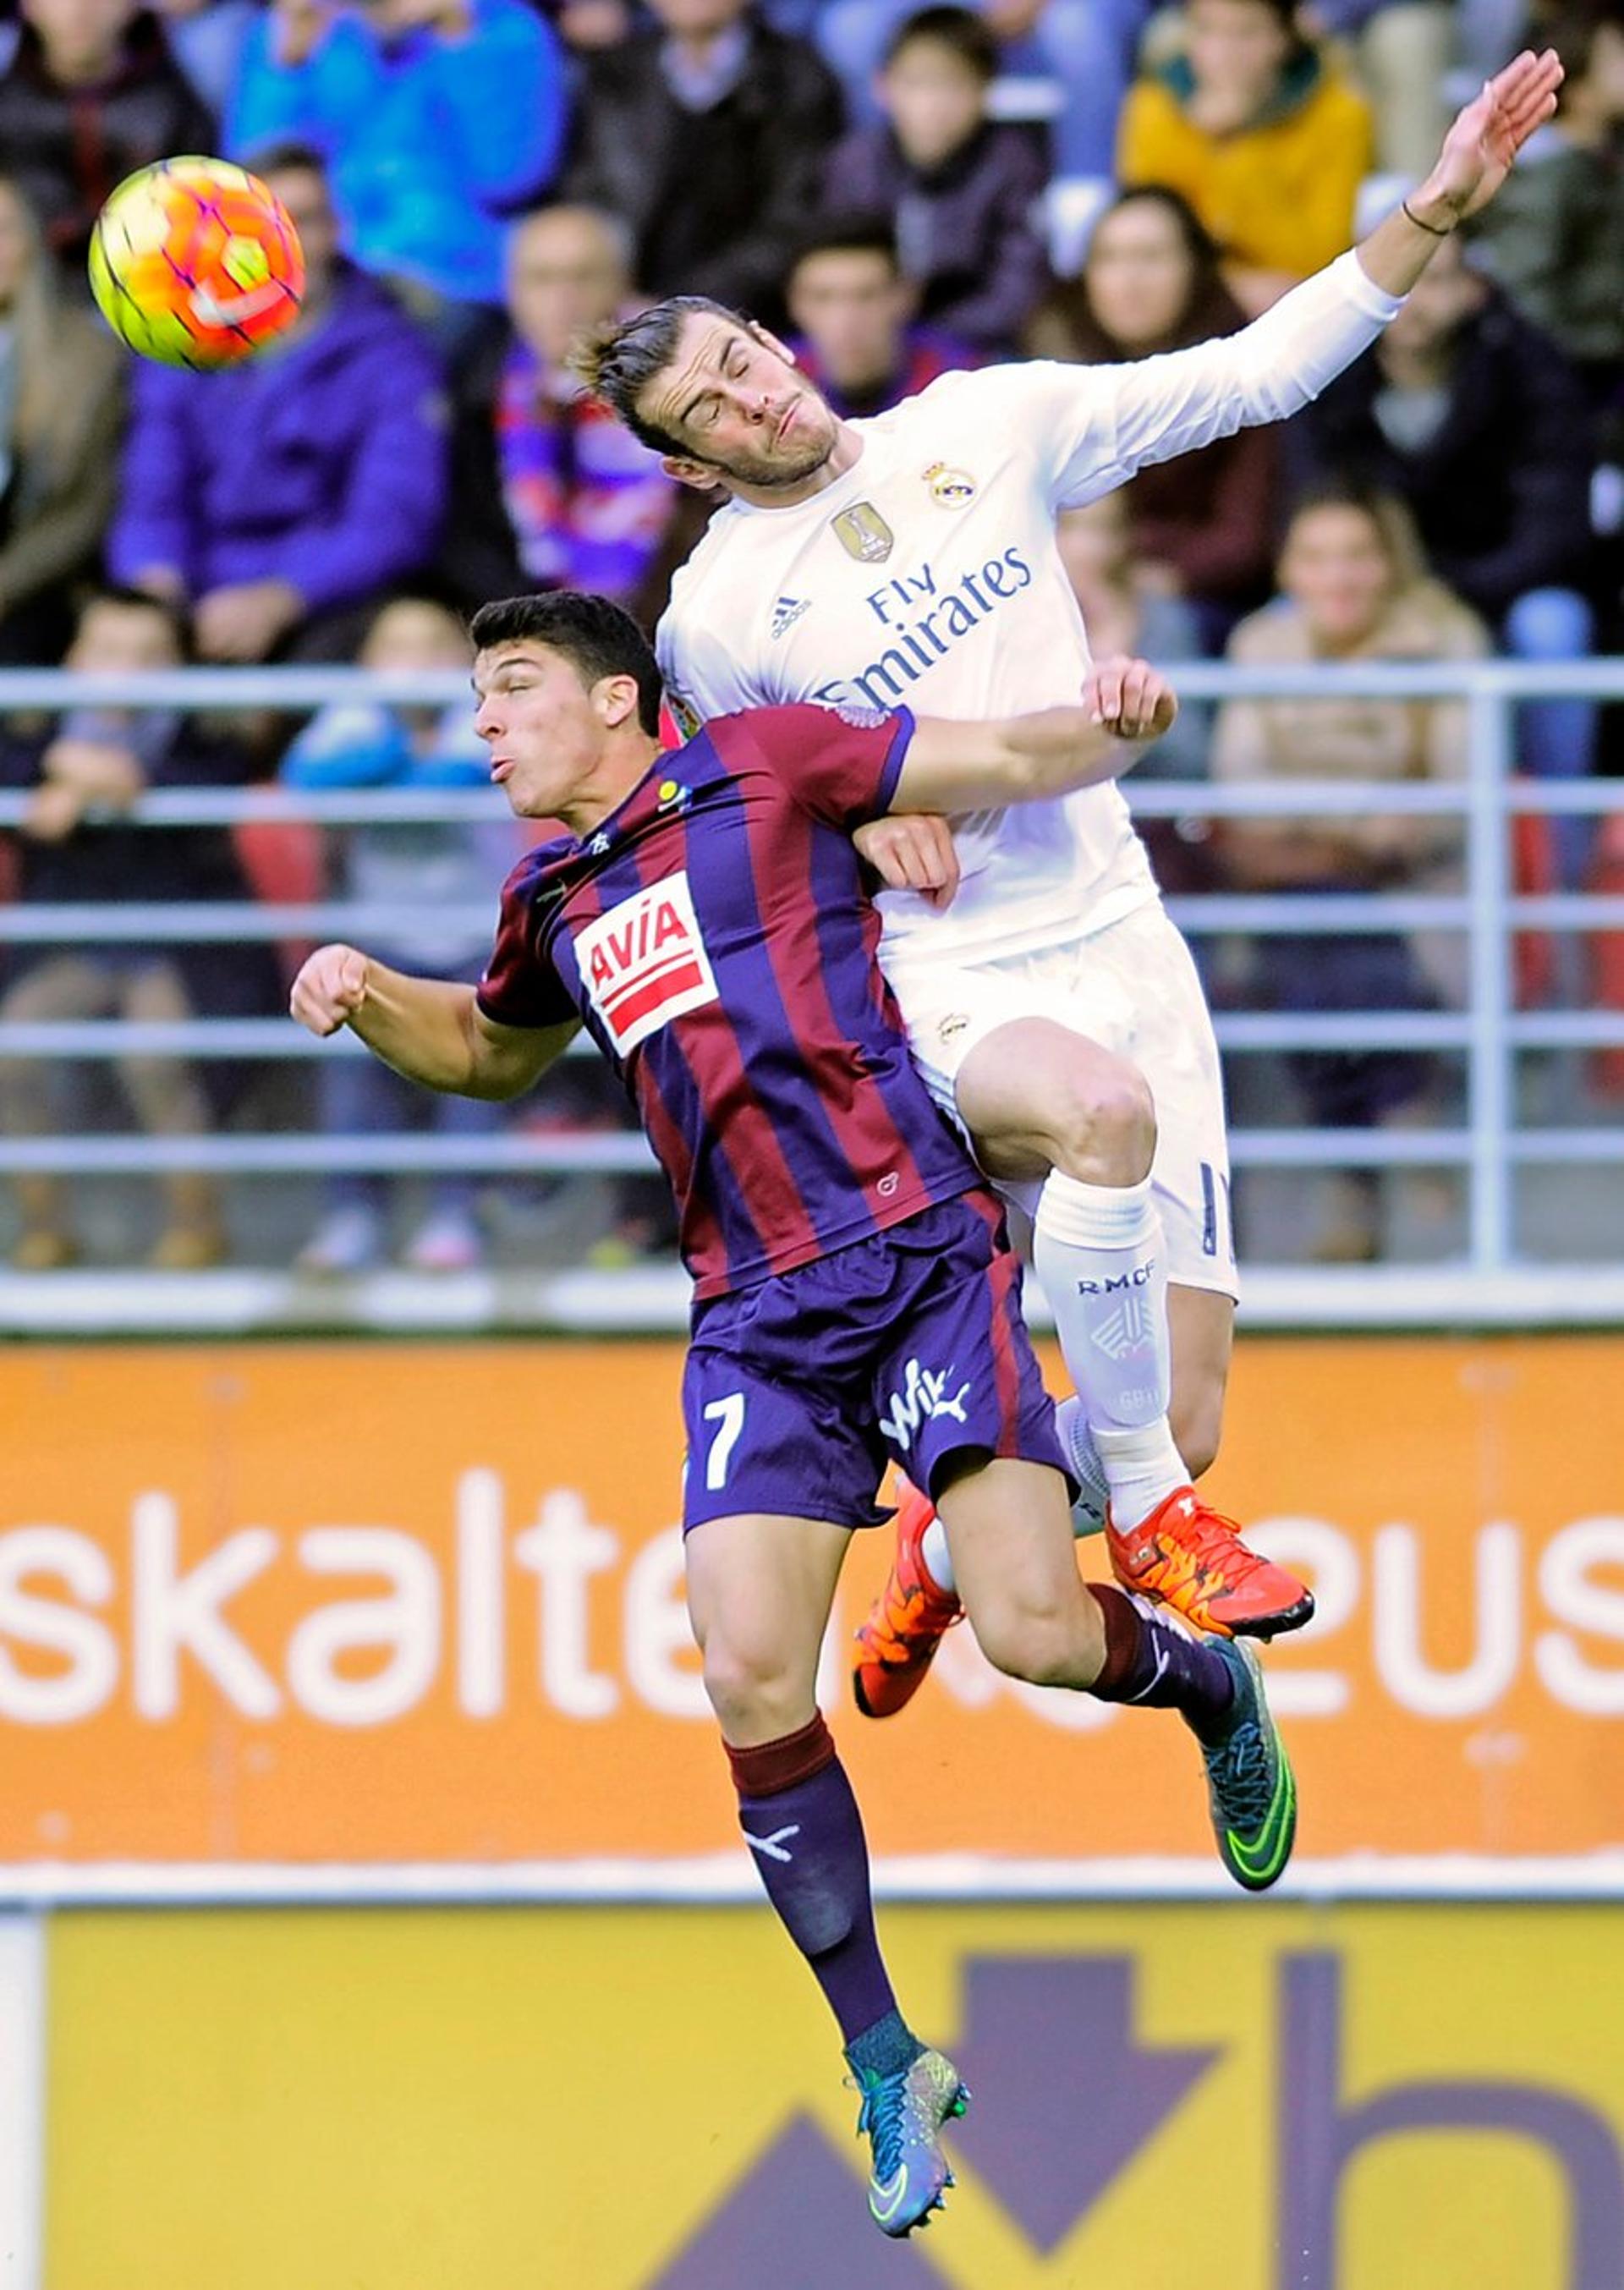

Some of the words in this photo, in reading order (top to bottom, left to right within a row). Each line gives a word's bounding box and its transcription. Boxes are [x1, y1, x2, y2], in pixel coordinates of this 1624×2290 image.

[866, 563, 936, 623] Fly
[590, 898, 689, 991] AVÍA
[1078, 1259, 1155, 1295] RMCF
[703, 1392, 745, 1491] 7
